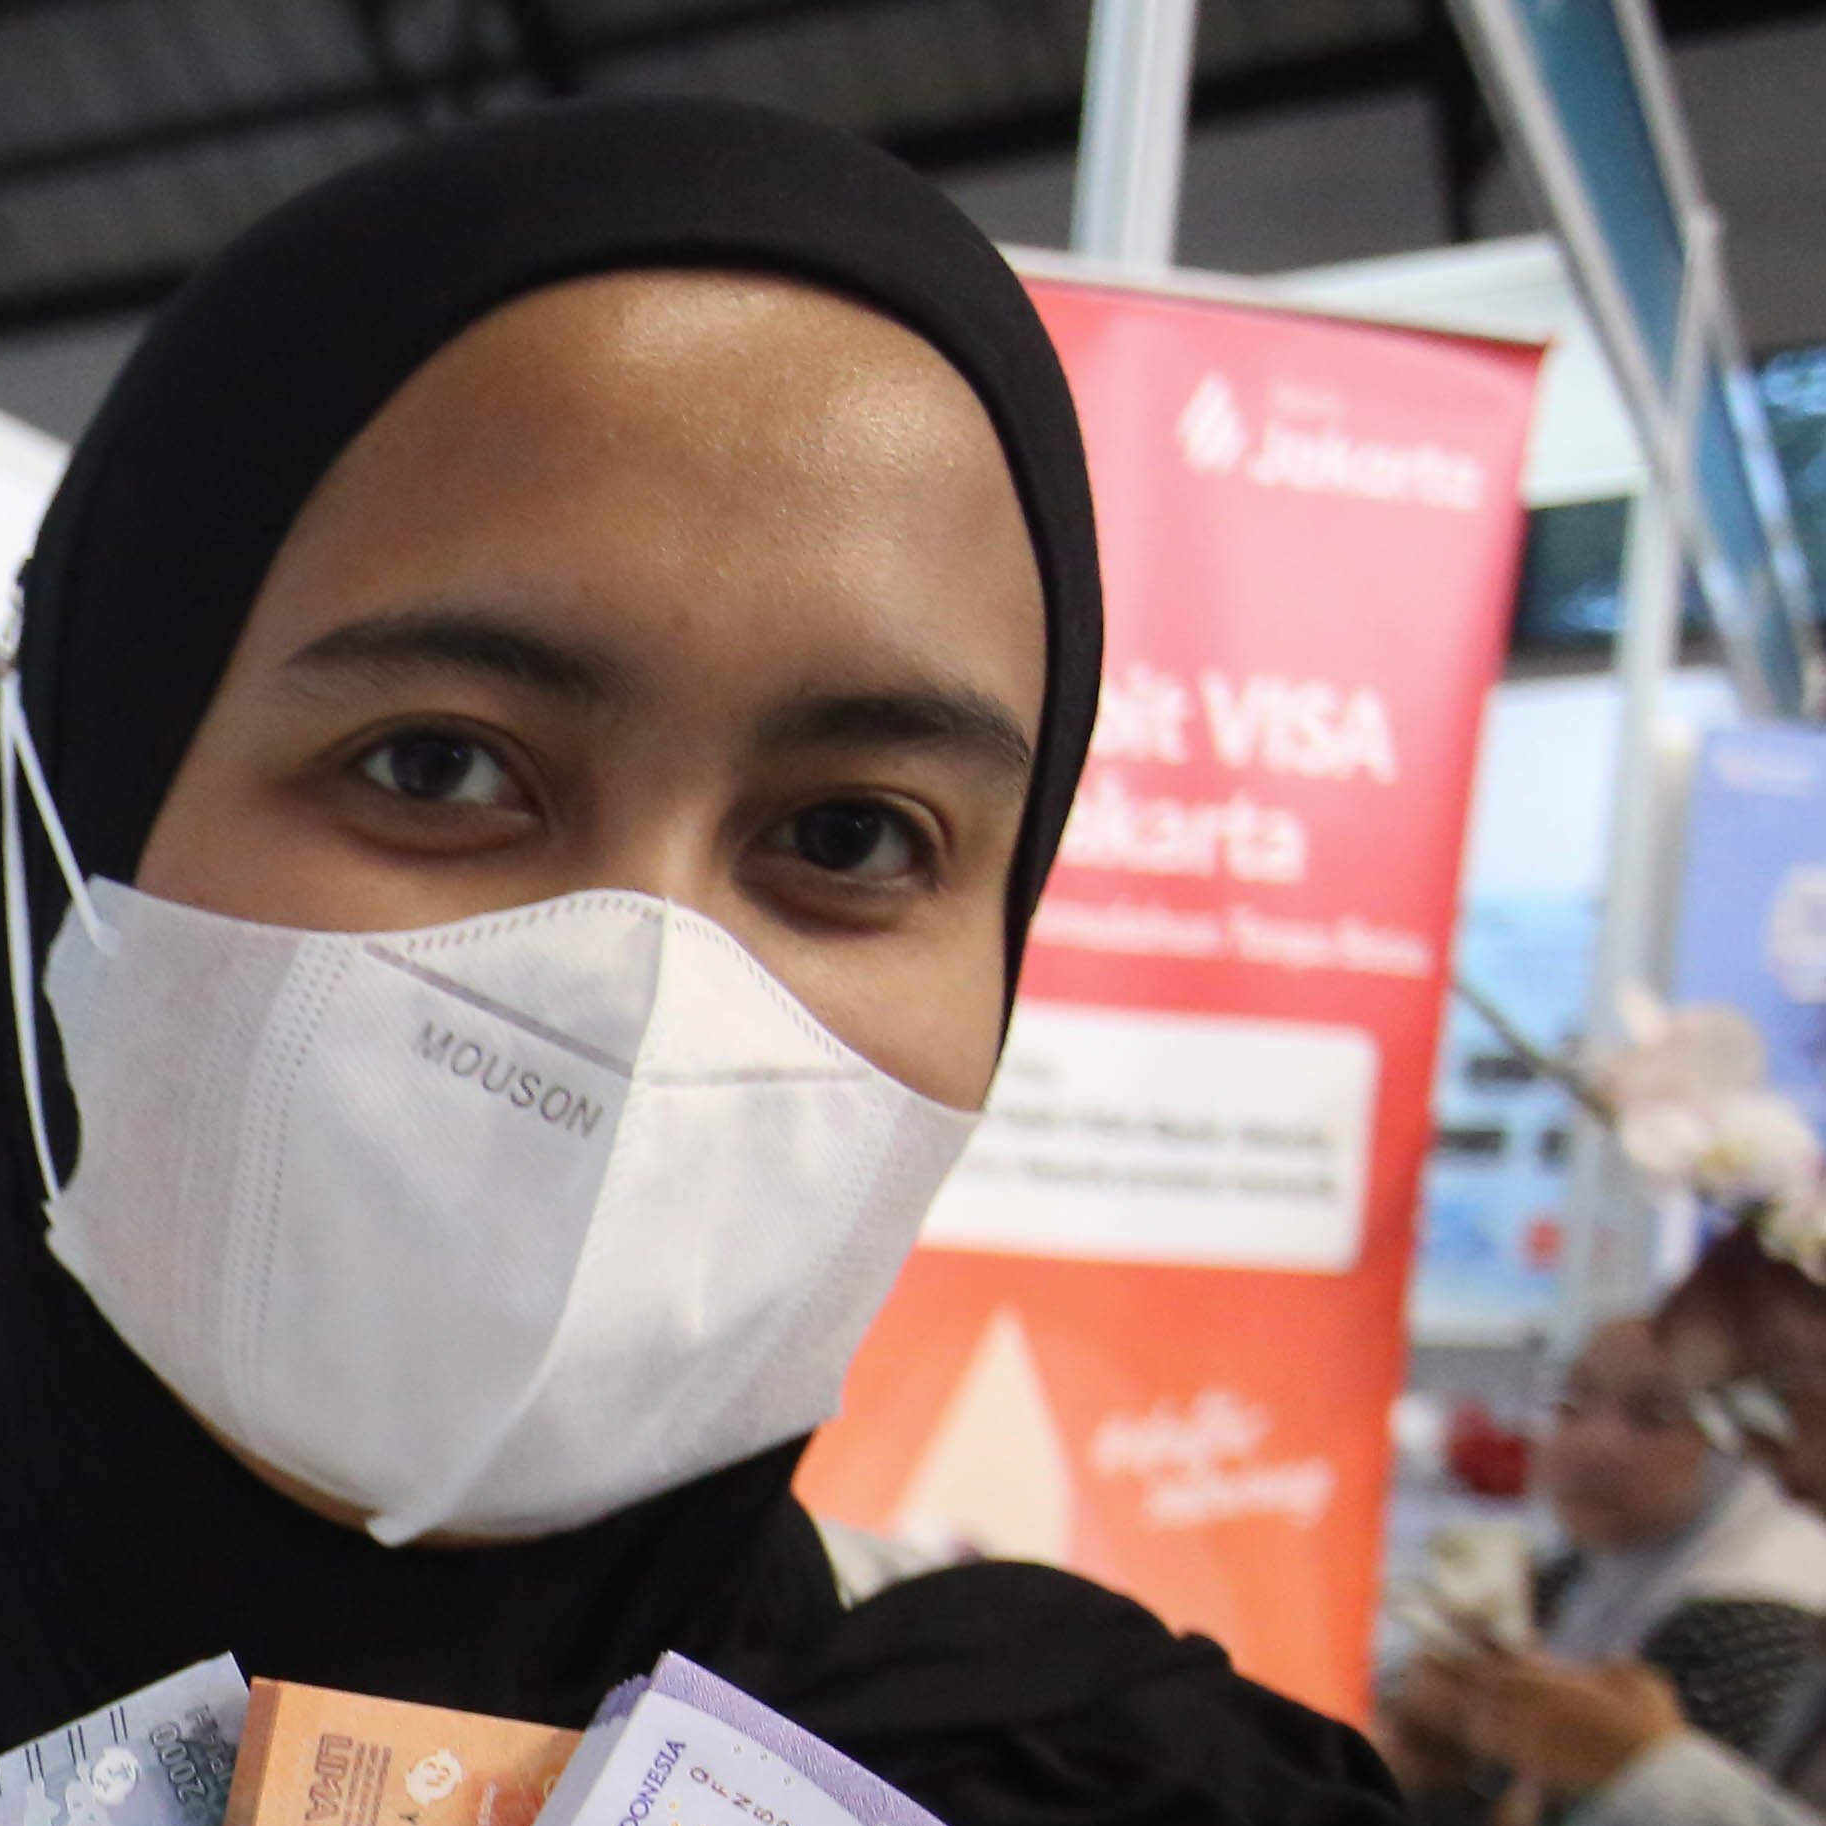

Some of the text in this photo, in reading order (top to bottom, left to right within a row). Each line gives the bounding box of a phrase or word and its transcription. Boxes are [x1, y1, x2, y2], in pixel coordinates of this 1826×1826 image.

[1202, 668, 1397, 783] VISA
[1059, 770, 1308, 881] akarta
[420, 1021, 603, 1138] MOUSON
[150, 1720, 209, 1804] 2000
[305, 1732, 353, 1822] LIMA
